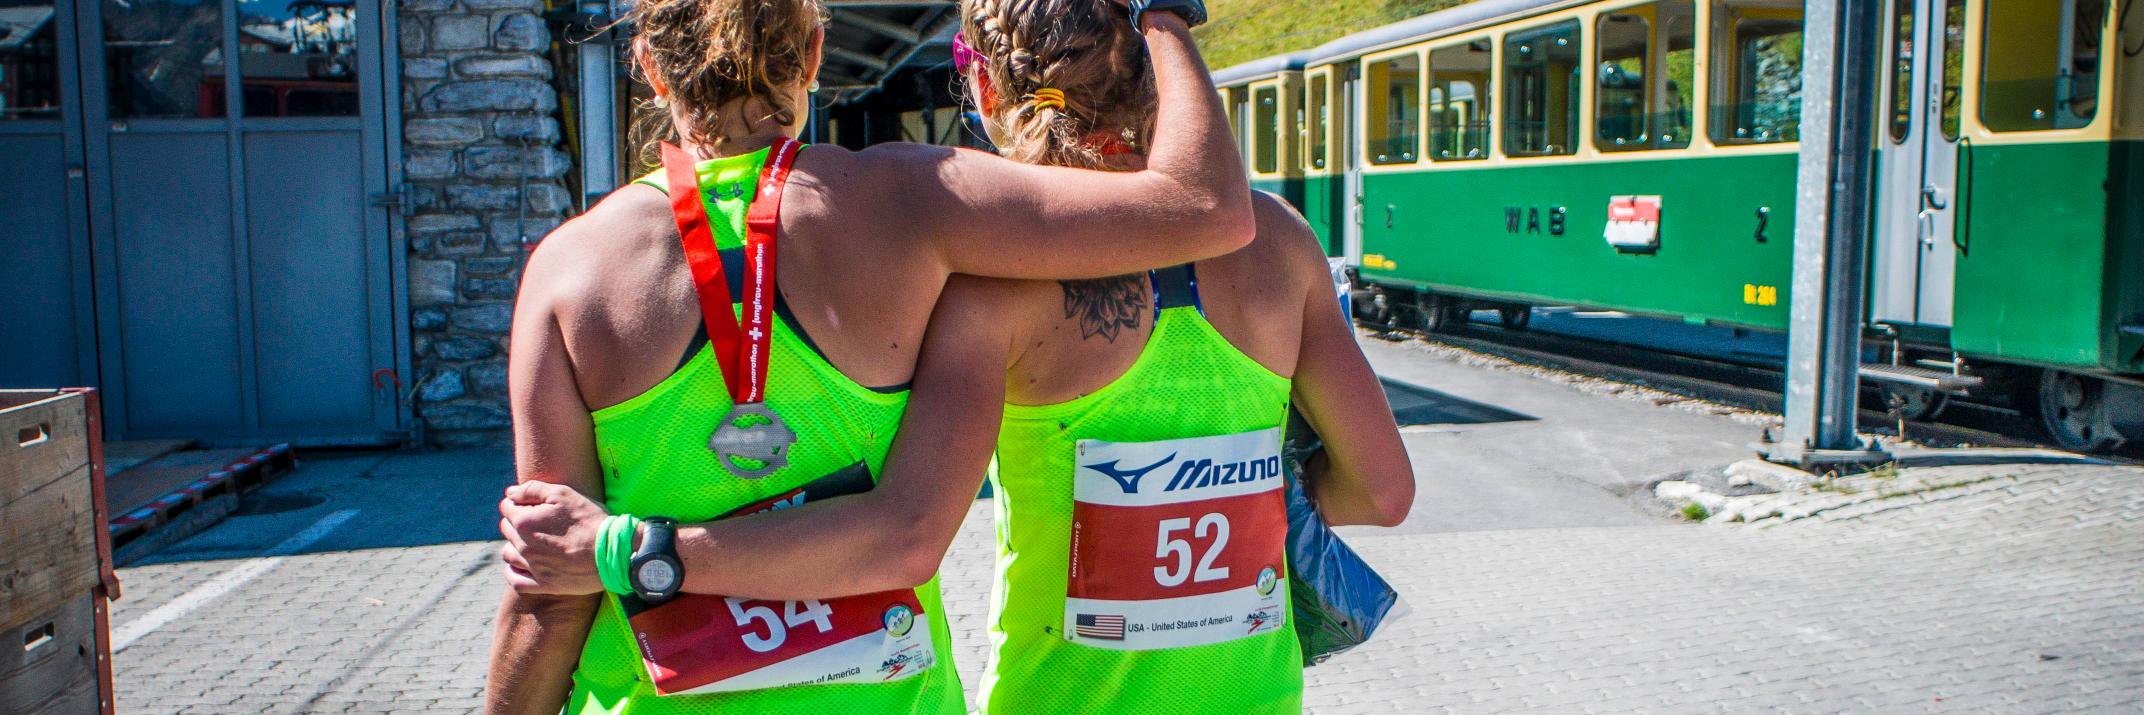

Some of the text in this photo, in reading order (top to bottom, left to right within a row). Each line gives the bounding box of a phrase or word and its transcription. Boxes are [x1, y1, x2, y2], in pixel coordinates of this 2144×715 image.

[1153, 512, 1230, 587] 52
[724, 599, 833, 653] 54
[1128, 623, 1144, 632] USA
[1152, 621, 1175, 632] United
[1177, 619, 1198, 630] States
[1200, 618, 1207, 627] of
[1208, 614, 1233, 626] America
[816, 675, 825, 684] of
[827, 666, 861, 682] America
